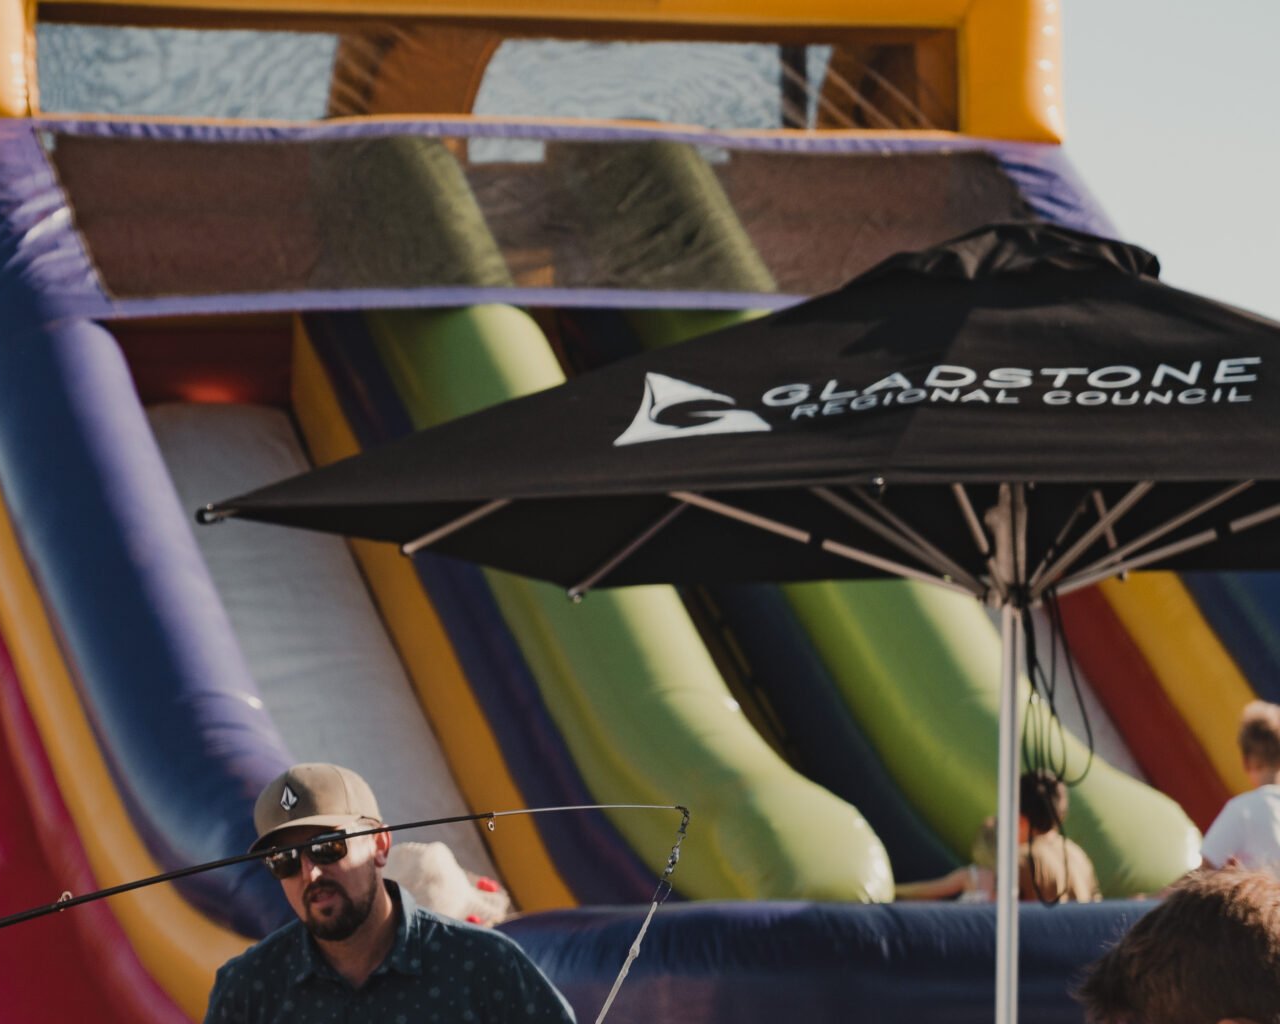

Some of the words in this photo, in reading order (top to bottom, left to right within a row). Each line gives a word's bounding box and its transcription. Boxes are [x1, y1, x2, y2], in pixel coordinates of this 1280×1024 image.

[762, 357, 1262, 407] GLADSTONE
[790, 388, 1019, 420] REGIONAL
[1042, 387, 1252, 405] COUNCIL
